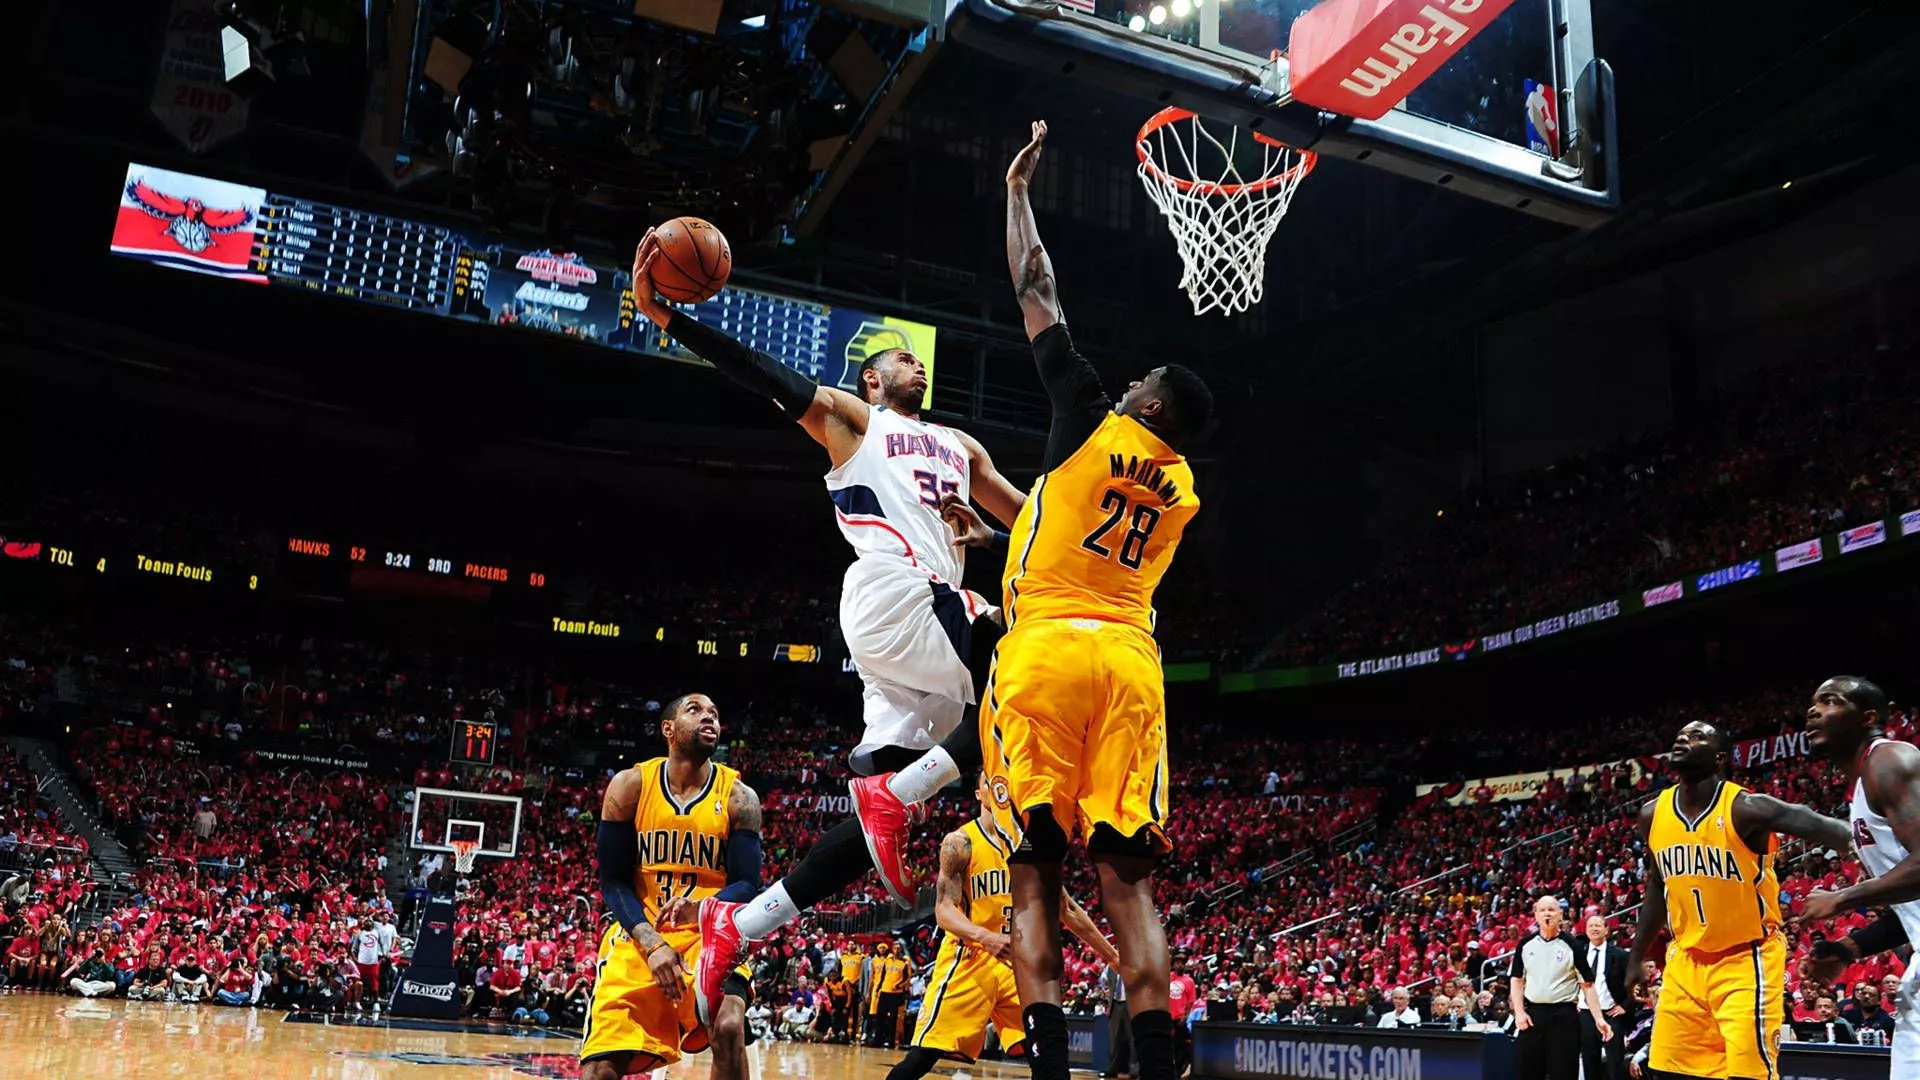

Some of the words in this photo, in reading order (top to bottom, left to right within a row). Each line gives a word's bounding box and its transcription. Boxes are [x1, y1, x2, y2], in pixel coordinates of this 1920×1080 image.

[1340, 4, 1470, 97] Farm
[519, 257, 560, 275] ATLANTA
[515, 281, 590, 312] Aaron's
[1080, 486, 1162, 571] 28
[50, 547, 74, 566] TOL
[96, 557, 106, 573] 4
[137, 554, 174, 576] Team
[176, 562, 213, 582] Fouls
[249, 575, 258, 589] 3
[289, 537, 330, 557] HAWKS
[386, 552, 412, 568] 3:24
[428, 558, 451, 574] 3RD
[465, 563, 508, 582] PACERS
[552, 617, 586, 634] Team
[587, 620, 620, 637] Fouls
[655, 627, 664, 641] 4
[1482, 632, 1514, 652] THANK
[1567, 599, 1620, 628] PARTNERS
[697, 640, 718, 656] TOL
[739, 643, 748, 656] 5
[1338, 662, 1357, 678] THE
[1360, 655, 1403, 676] ATLANTA
[1405, 647, 1441, 668] HAWKS
[465, 725, 491, 738] 3:24
[466, 738, 487, 759] 11
[1746, 730, 1812, 769] PLAYO
[1657, 843, 1744, 883] INDIANA
[970, 868, 1011, 901] INDI
[1691, 887, 1707, 926] 1
[1243, 1038, 1422, 1080] NBATICKETS.COM
